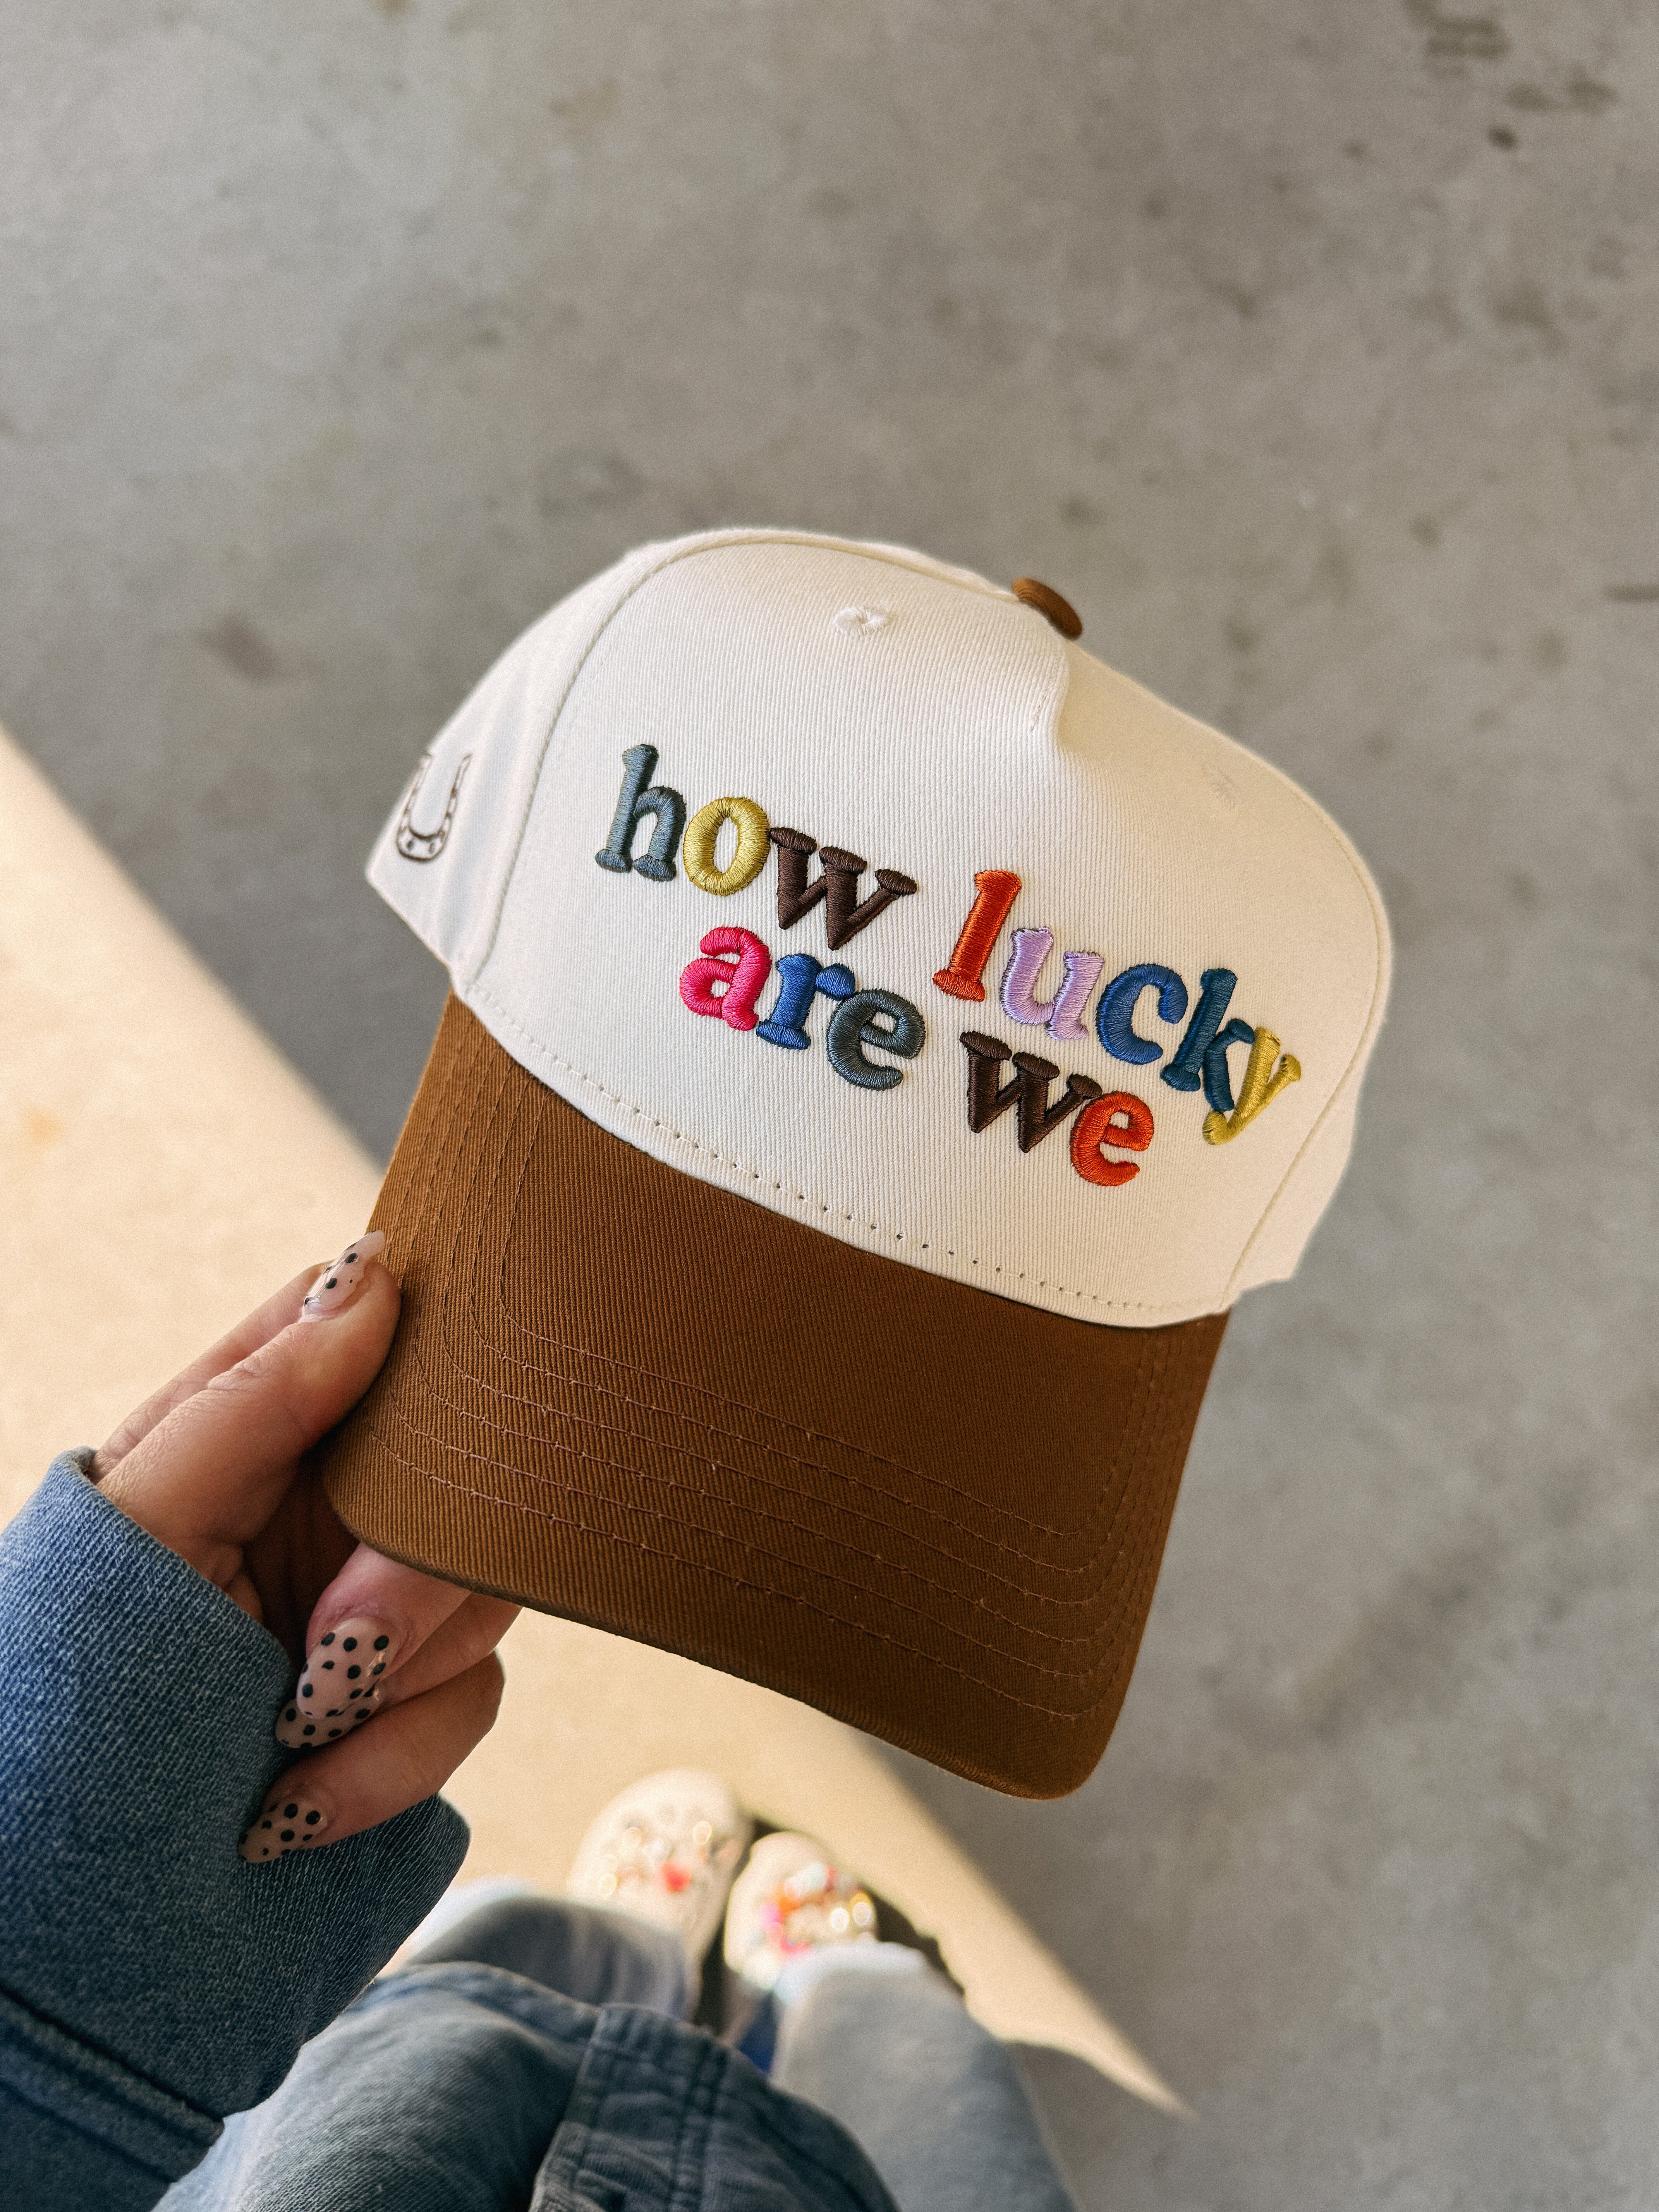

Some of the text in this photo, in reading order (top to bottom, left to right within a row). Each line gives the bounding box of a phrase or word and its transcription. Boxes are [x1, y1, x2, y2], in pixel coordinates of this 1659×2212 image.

[594, 744, 1301, 1145] how lucky
[679, 926, 1154, 1186] are we
